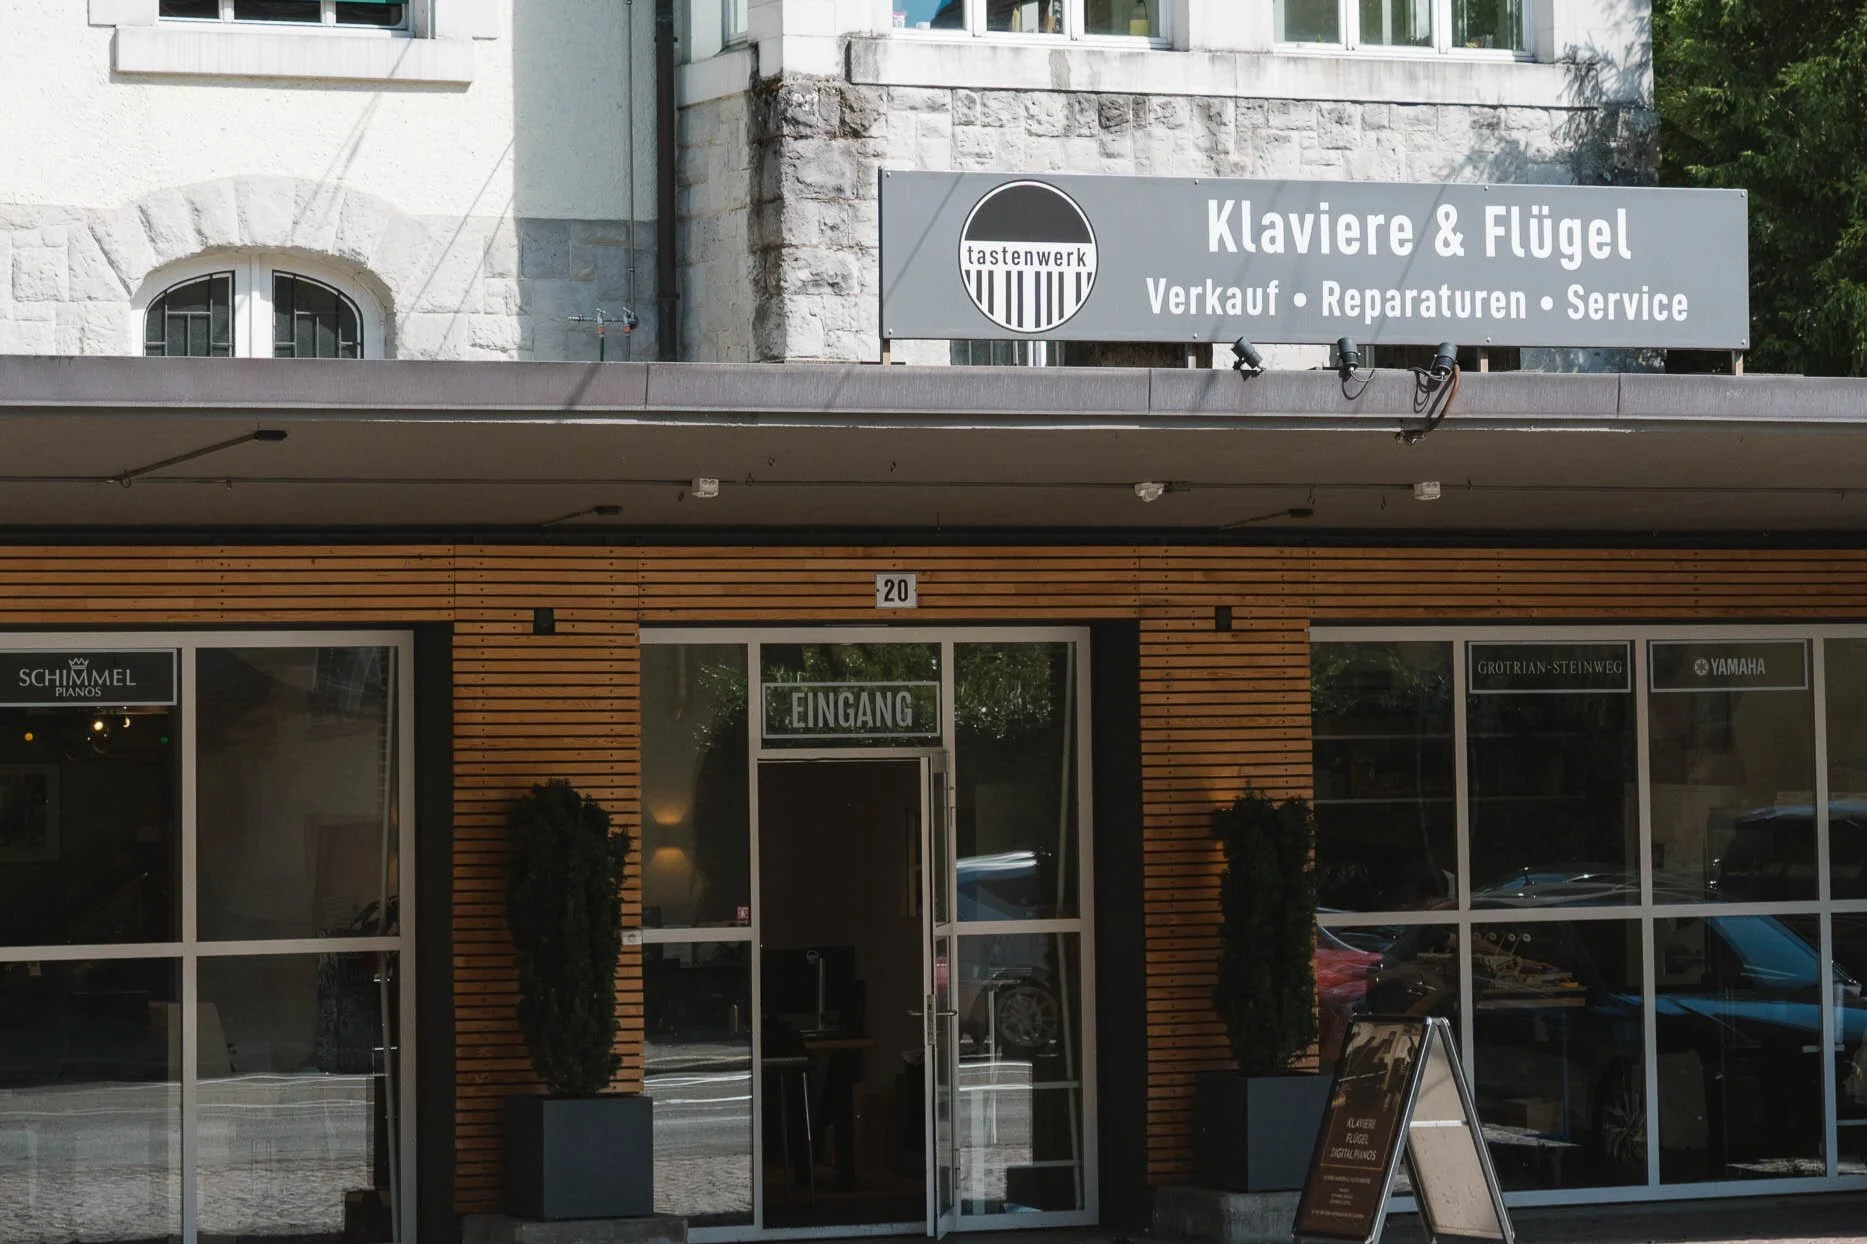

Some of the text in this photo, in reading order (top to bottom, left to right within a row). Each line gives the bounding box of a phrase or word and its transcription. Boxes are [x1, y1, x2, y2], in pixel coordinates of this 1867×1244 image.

[1207, 199, 1632, 271] Klaviere & Flügel
[967, 245, 1087, 267] tastenwerk
[1145, 277, 1689, 325] Verkauf Reparaturen Service
[883, 578, 909, 602] 20
[1477, 660, 1623, 675] GROTRIAN-STEINWEG
[1710, 657, 1766, 676] YAMAHA
[18, 668, 137, 687] SCHIMMEL
[55, 686, 102, 697] PIANOS
[791, 690, 913, 729] EINGANG
[1346, 1117, 1377, 1130] KLAVIERE
